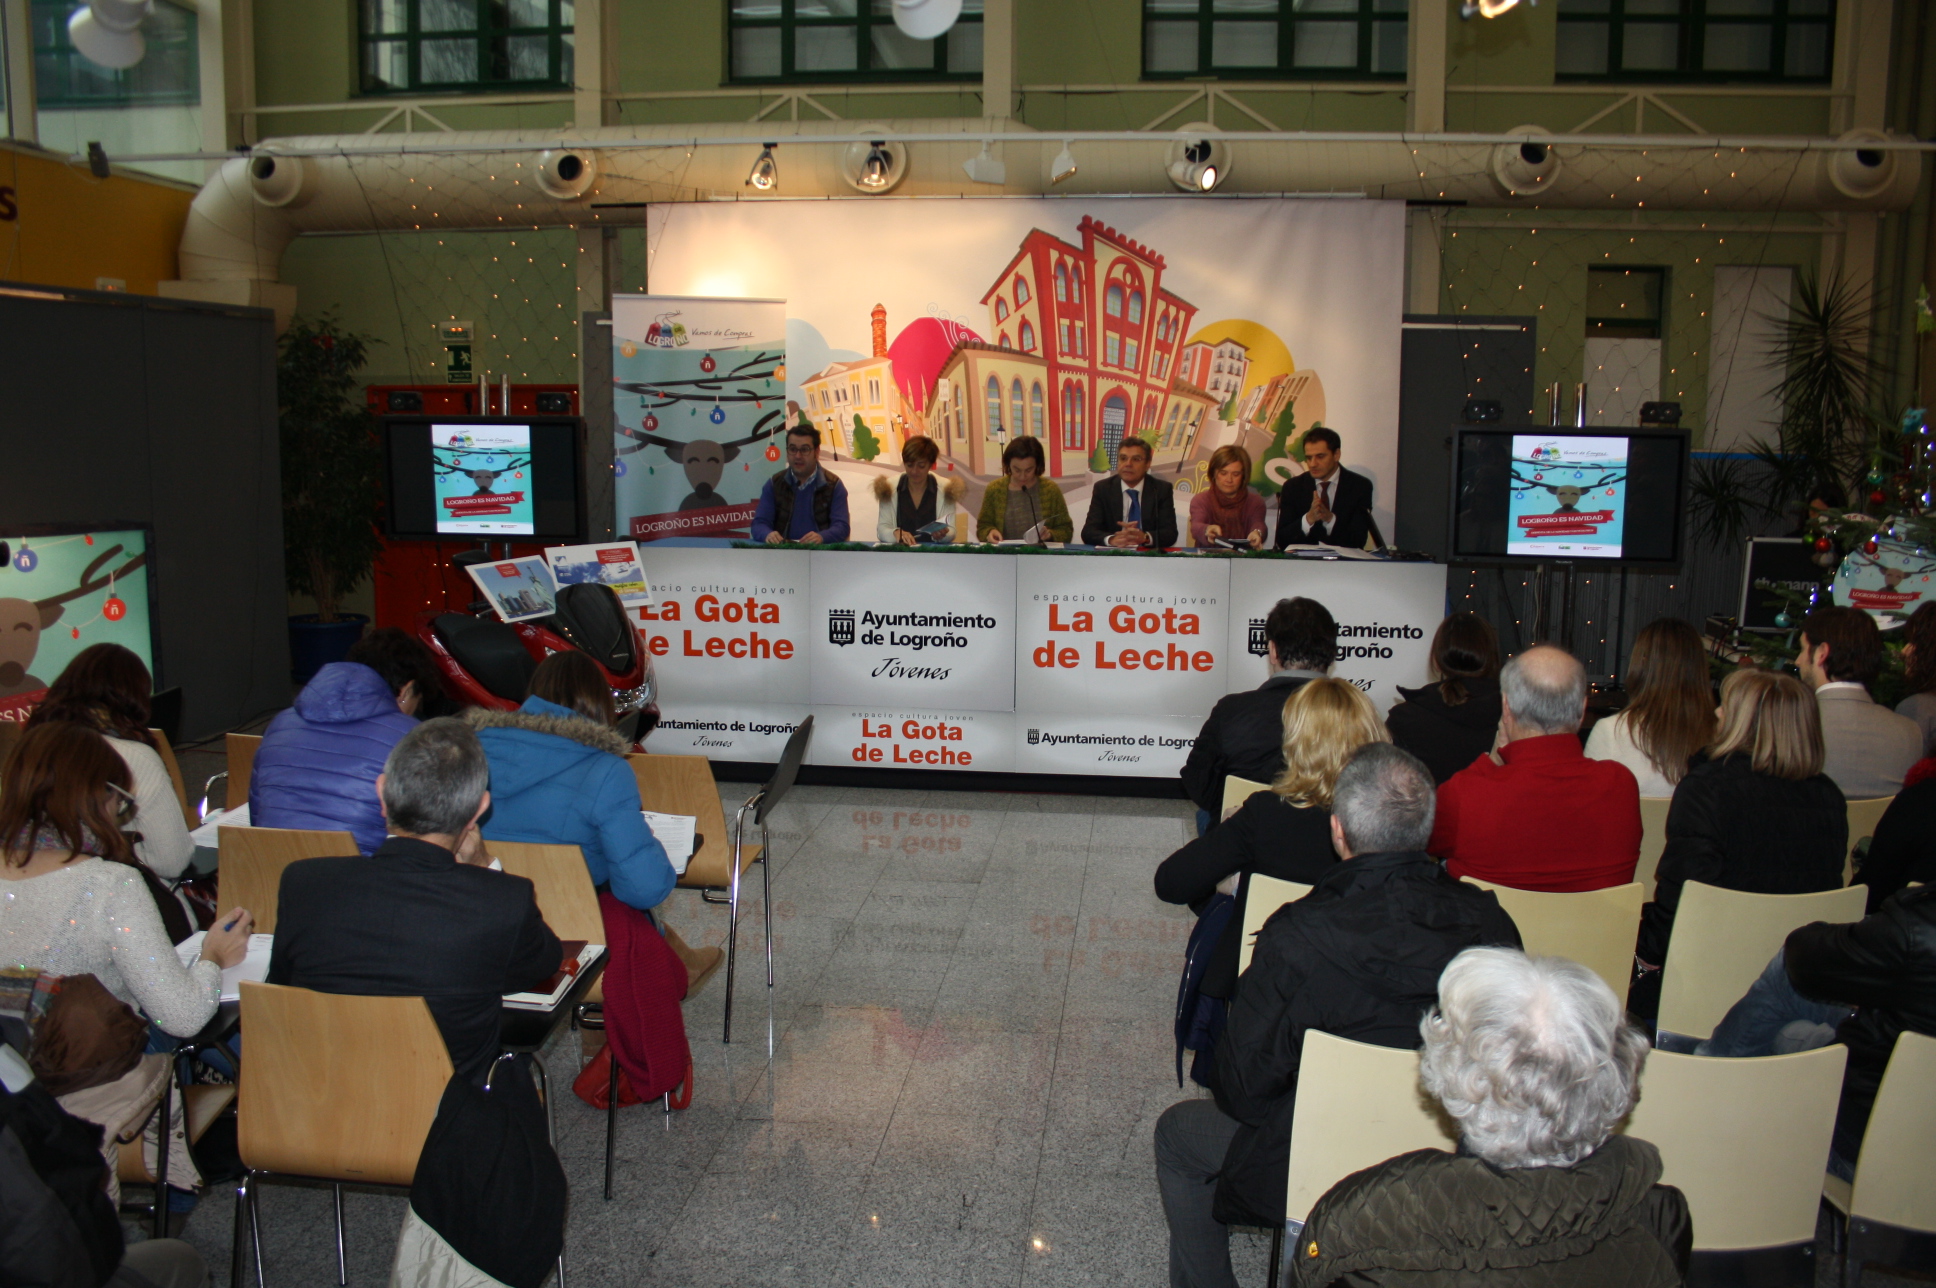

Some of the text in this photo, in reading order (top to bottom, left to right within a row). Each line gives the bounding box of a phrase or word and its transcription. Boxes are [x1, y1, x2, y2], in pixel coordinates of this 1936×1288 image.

[635, 518, 690, 534] LOGROÑO
[692, 517, 705, 527] ES
[1568, 514, 1604, 522] NAVIDAD
[651, 584, 795, 595] acio cultura joven
[694, 594, 780, 623] Gota
[1033, 594, 1217, 605] espacio cultura joven
[861, 610, 996, 629] Ayuntamiento
[1048, 603, 1200, 635] La Gota
[861, 629, 968, 650] de Logroño
[1335, 622, 1423, 639] tamiento
[641, 628, 669, 656] e
[683, 629, 794, 660] Leche
[1033, 640, 1214, 672] de Leche
[1335, 643, 1393, 661] groño
[871, 657, 952, 680] Jóvenes
[656, 719, 727, 731] untamiento
[730, 721, 745, 732] de
[862, 719, 962, 740] La Gota
[693, 735, 734, 748] Jóvenes
[1041, 732, 1196, 749] Ayuntamiento de Logro
[852, 743, 972, 765] de Leche
[1098, 750, 1141, 762] Jóvenes
